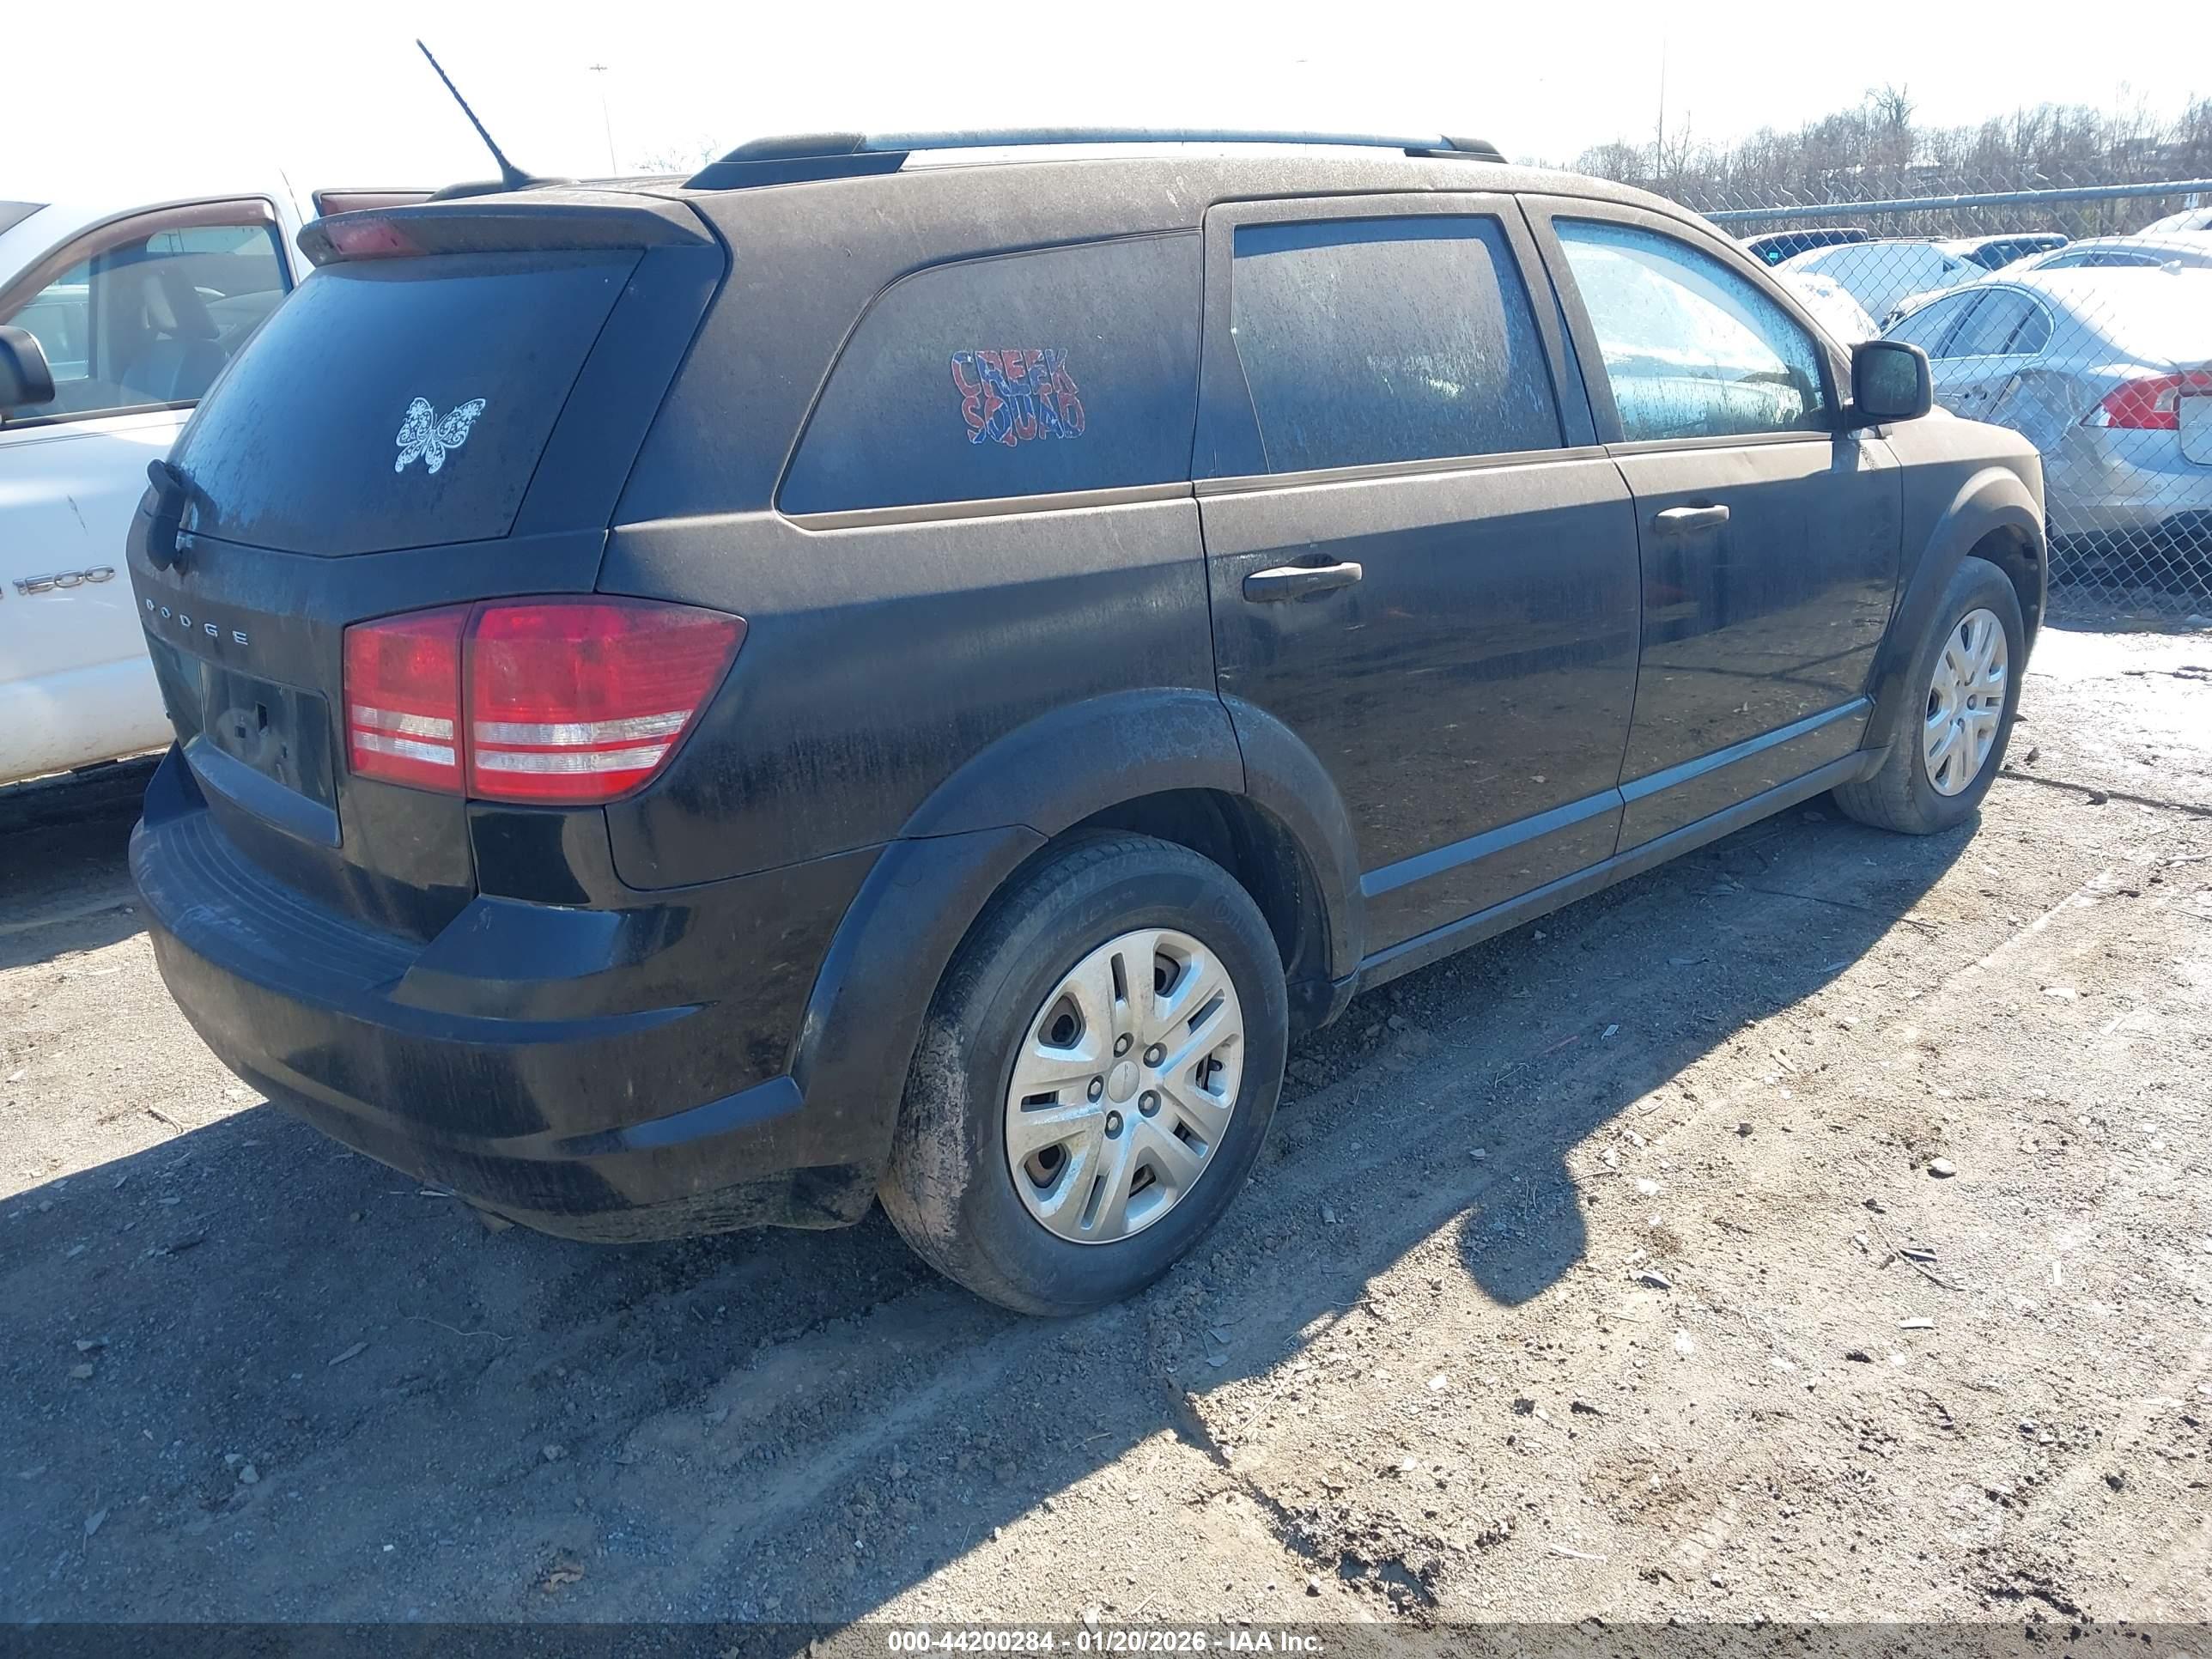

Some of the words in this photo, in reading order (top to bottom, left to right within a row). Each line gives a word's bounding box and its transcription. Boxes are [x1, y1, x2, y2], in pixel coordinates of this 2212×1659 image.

[951, 348, 1079, 398] CREEK
[961, 383, 1085, 447] SQUAD
[12, 565, 116, 596] 1500
[145, 598, 249, 646] DODGE
